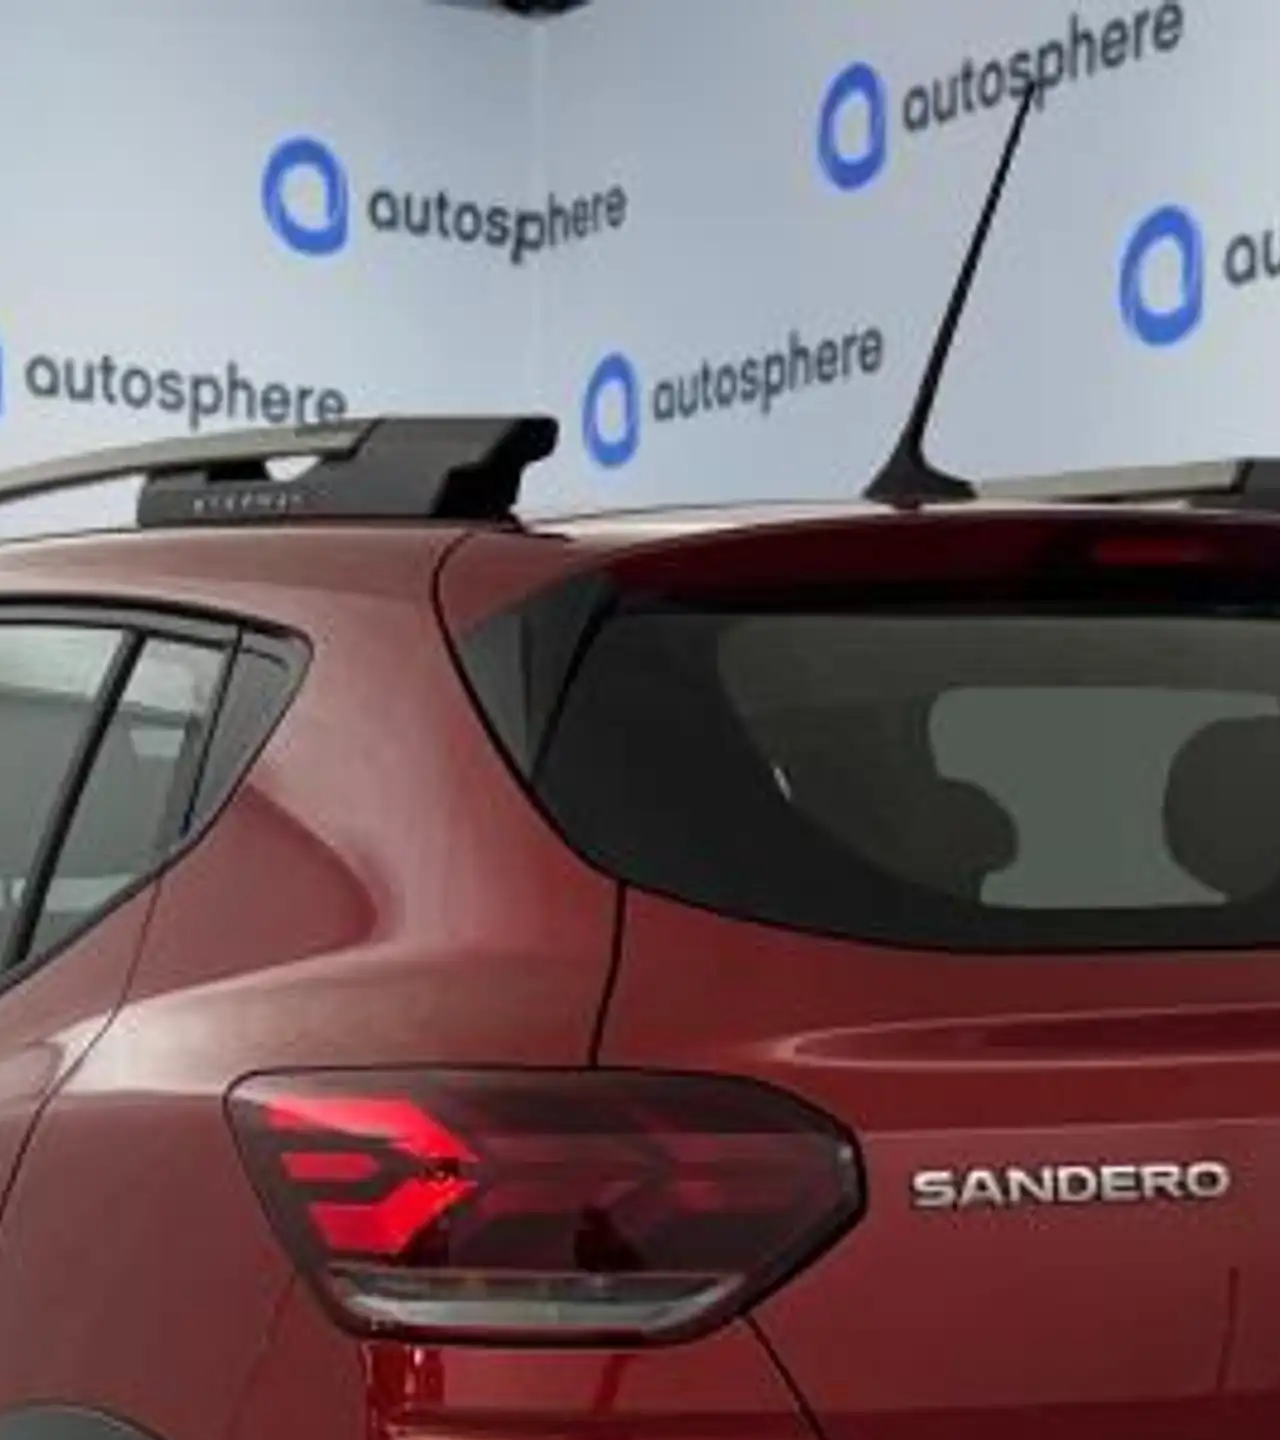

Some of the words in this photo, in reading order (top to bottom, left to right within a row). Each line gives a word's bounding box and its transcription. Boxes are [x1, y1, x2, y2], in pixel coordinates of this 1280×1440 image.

[903, 0, 1184, 132] autosphere
[368, 186, 627, 265] autosphere
[24, 354, 349, 430] autosphere
[652, 326, 883, 421] autosphere
[911, 1160, 1231, 1209] SANDERO
